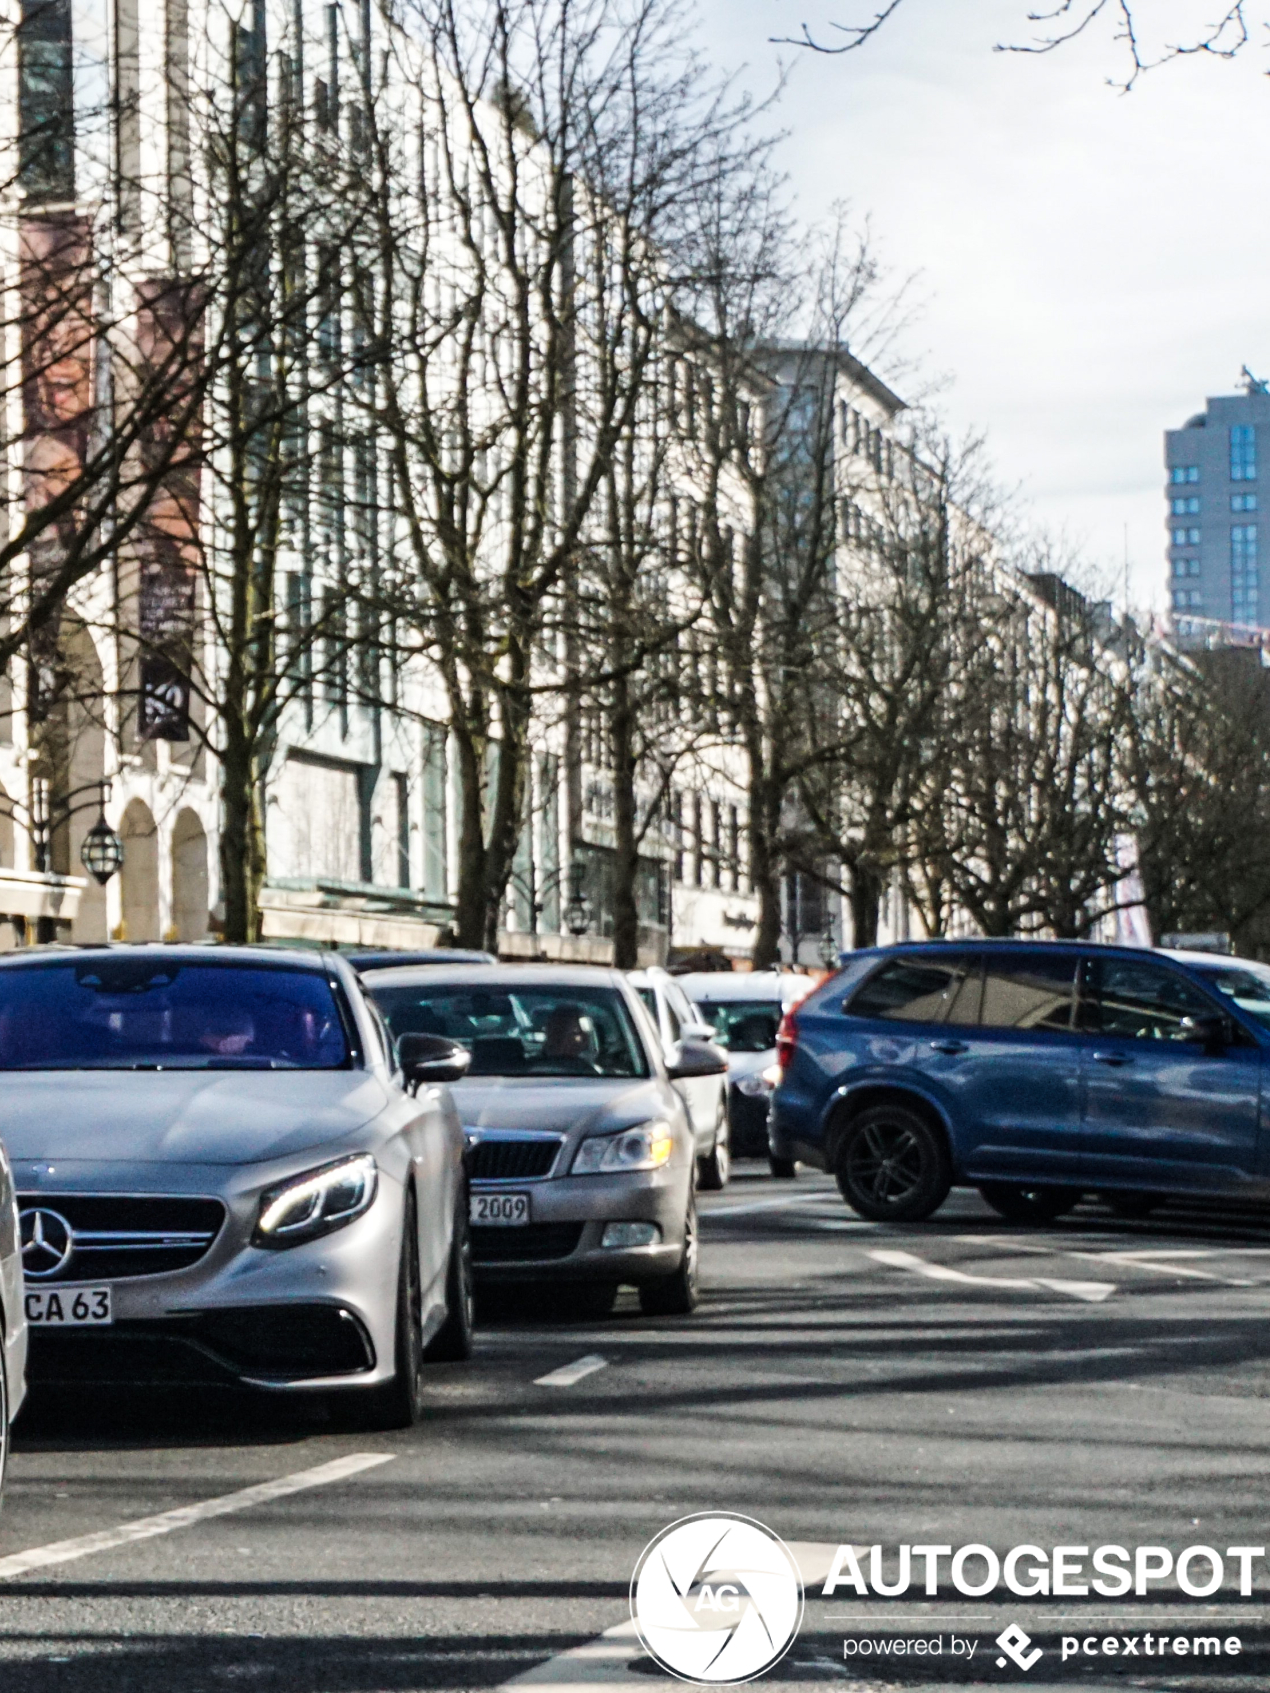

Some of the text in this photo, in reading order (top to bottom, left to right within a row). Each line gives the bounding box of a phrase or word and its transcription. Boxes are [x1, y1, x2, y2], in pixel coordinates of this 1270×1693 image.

[478, 1197, 526, 1219] 2009
[24, 1291, 109, 1322] CA 63
